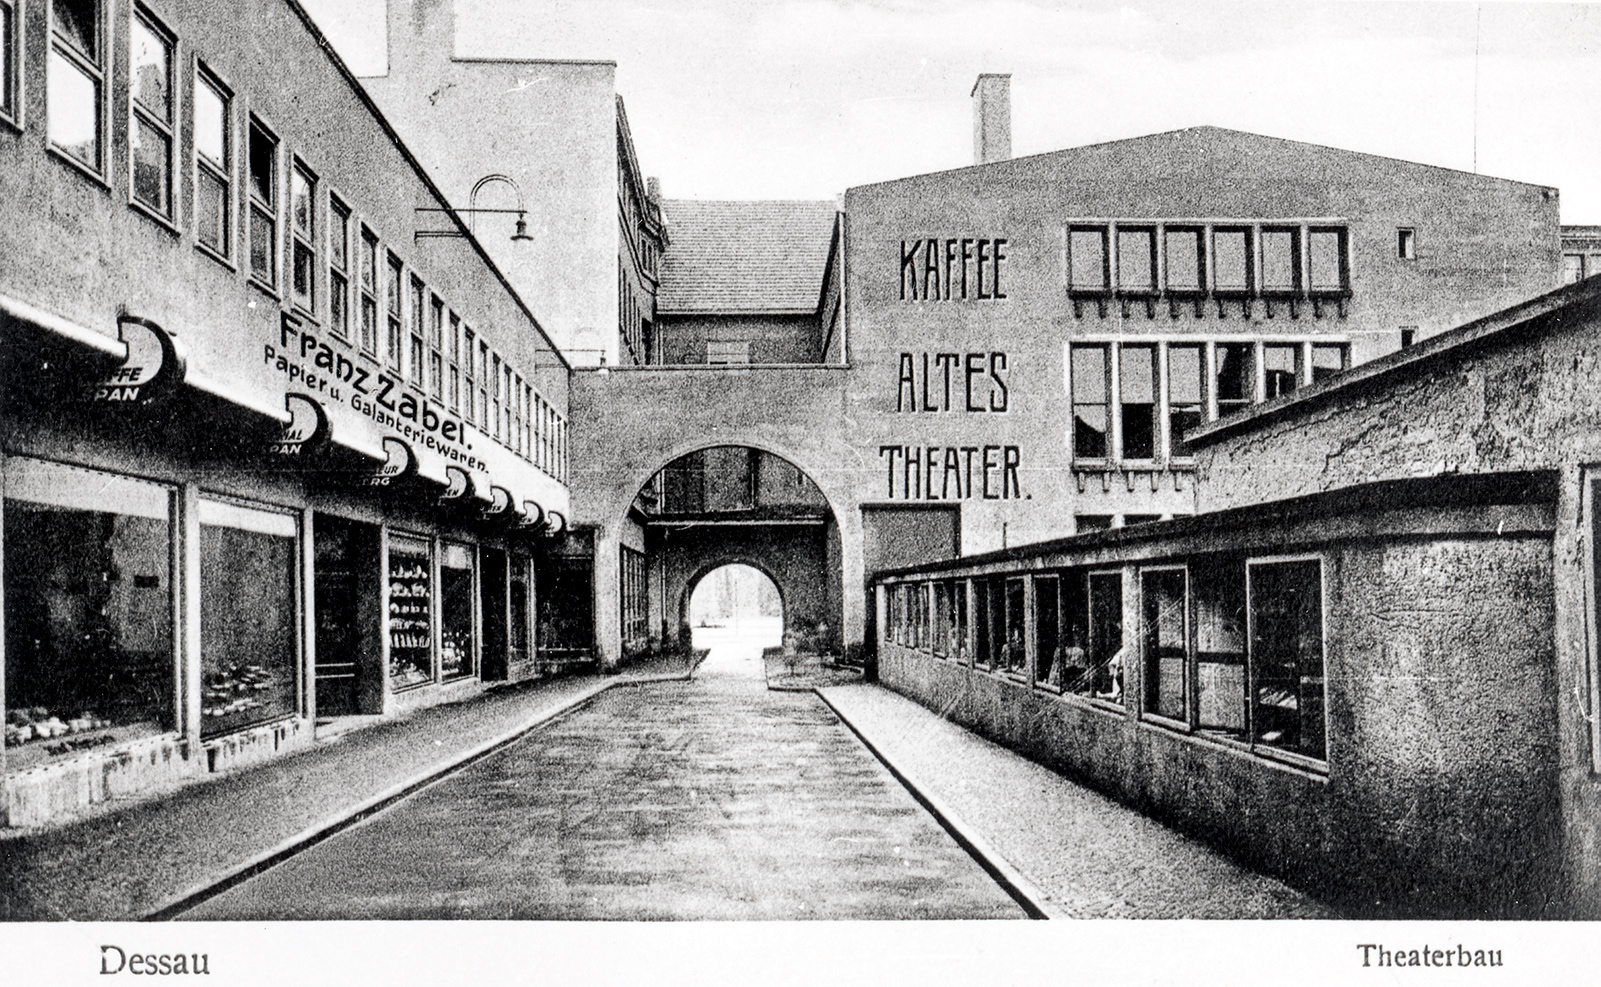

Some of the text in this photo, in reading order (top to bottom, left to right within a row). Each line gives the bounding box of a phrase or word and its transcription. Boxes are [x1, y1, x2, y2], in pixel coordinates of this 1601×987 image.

[900, 238, 1008, 300] KAFFEE
[264, 344, 490, 474] Papier u. Galanteriewaren.
[280, 310, 473, 450] Franz Zabel.
[898, 352, 1009, 412] ALTES
[879, 445, 1032, 500] THEATER.
